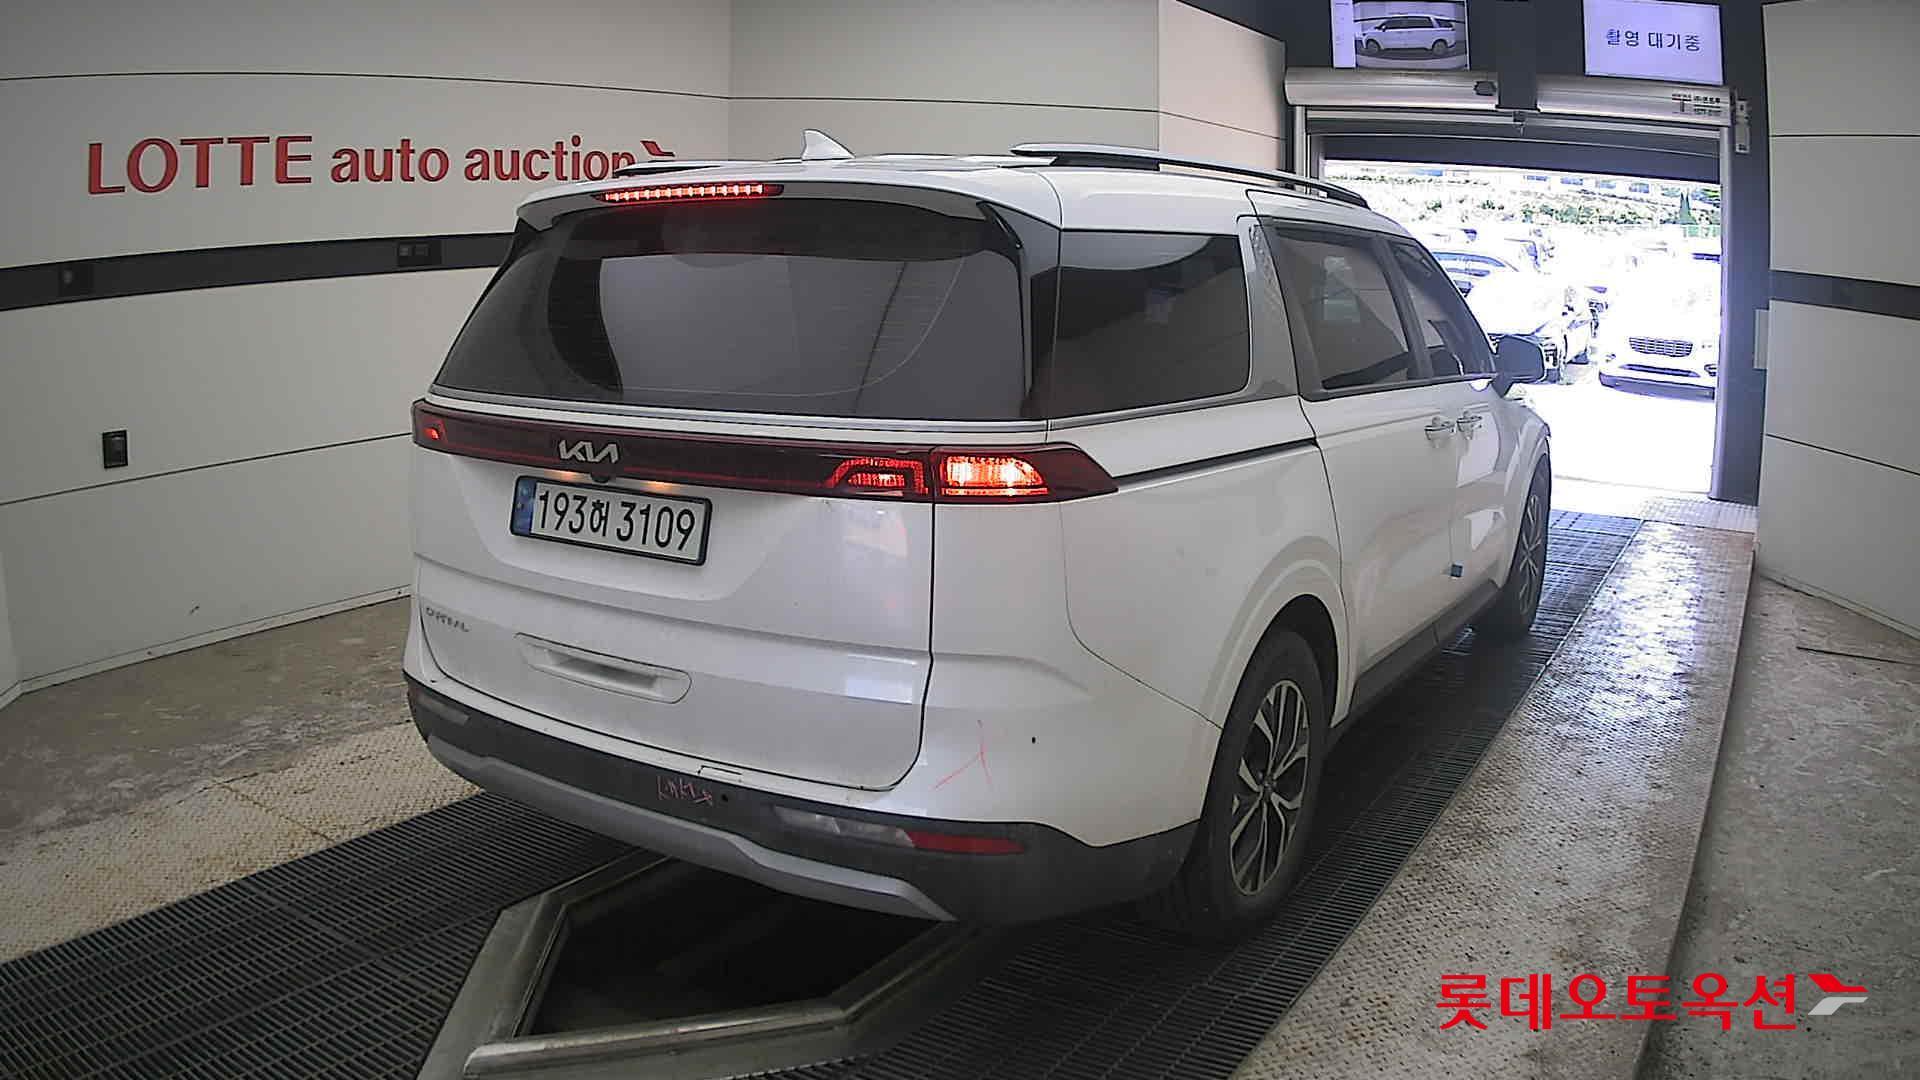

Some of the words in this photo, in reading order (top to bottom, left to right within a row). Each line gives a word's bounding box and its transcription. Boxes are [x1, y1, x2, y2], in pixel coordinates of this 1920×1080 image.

[1648, 32, 1701, 52] 대기중
[88, 135, 312, 194] LOTTE
[330, 138, 449, 182] auto
[464, 135, 636, 182] auction
[559, 439, 619, 463] KIA
[539, 490, 610, 537] 193허
[616, 501, 695, 550] 3109
